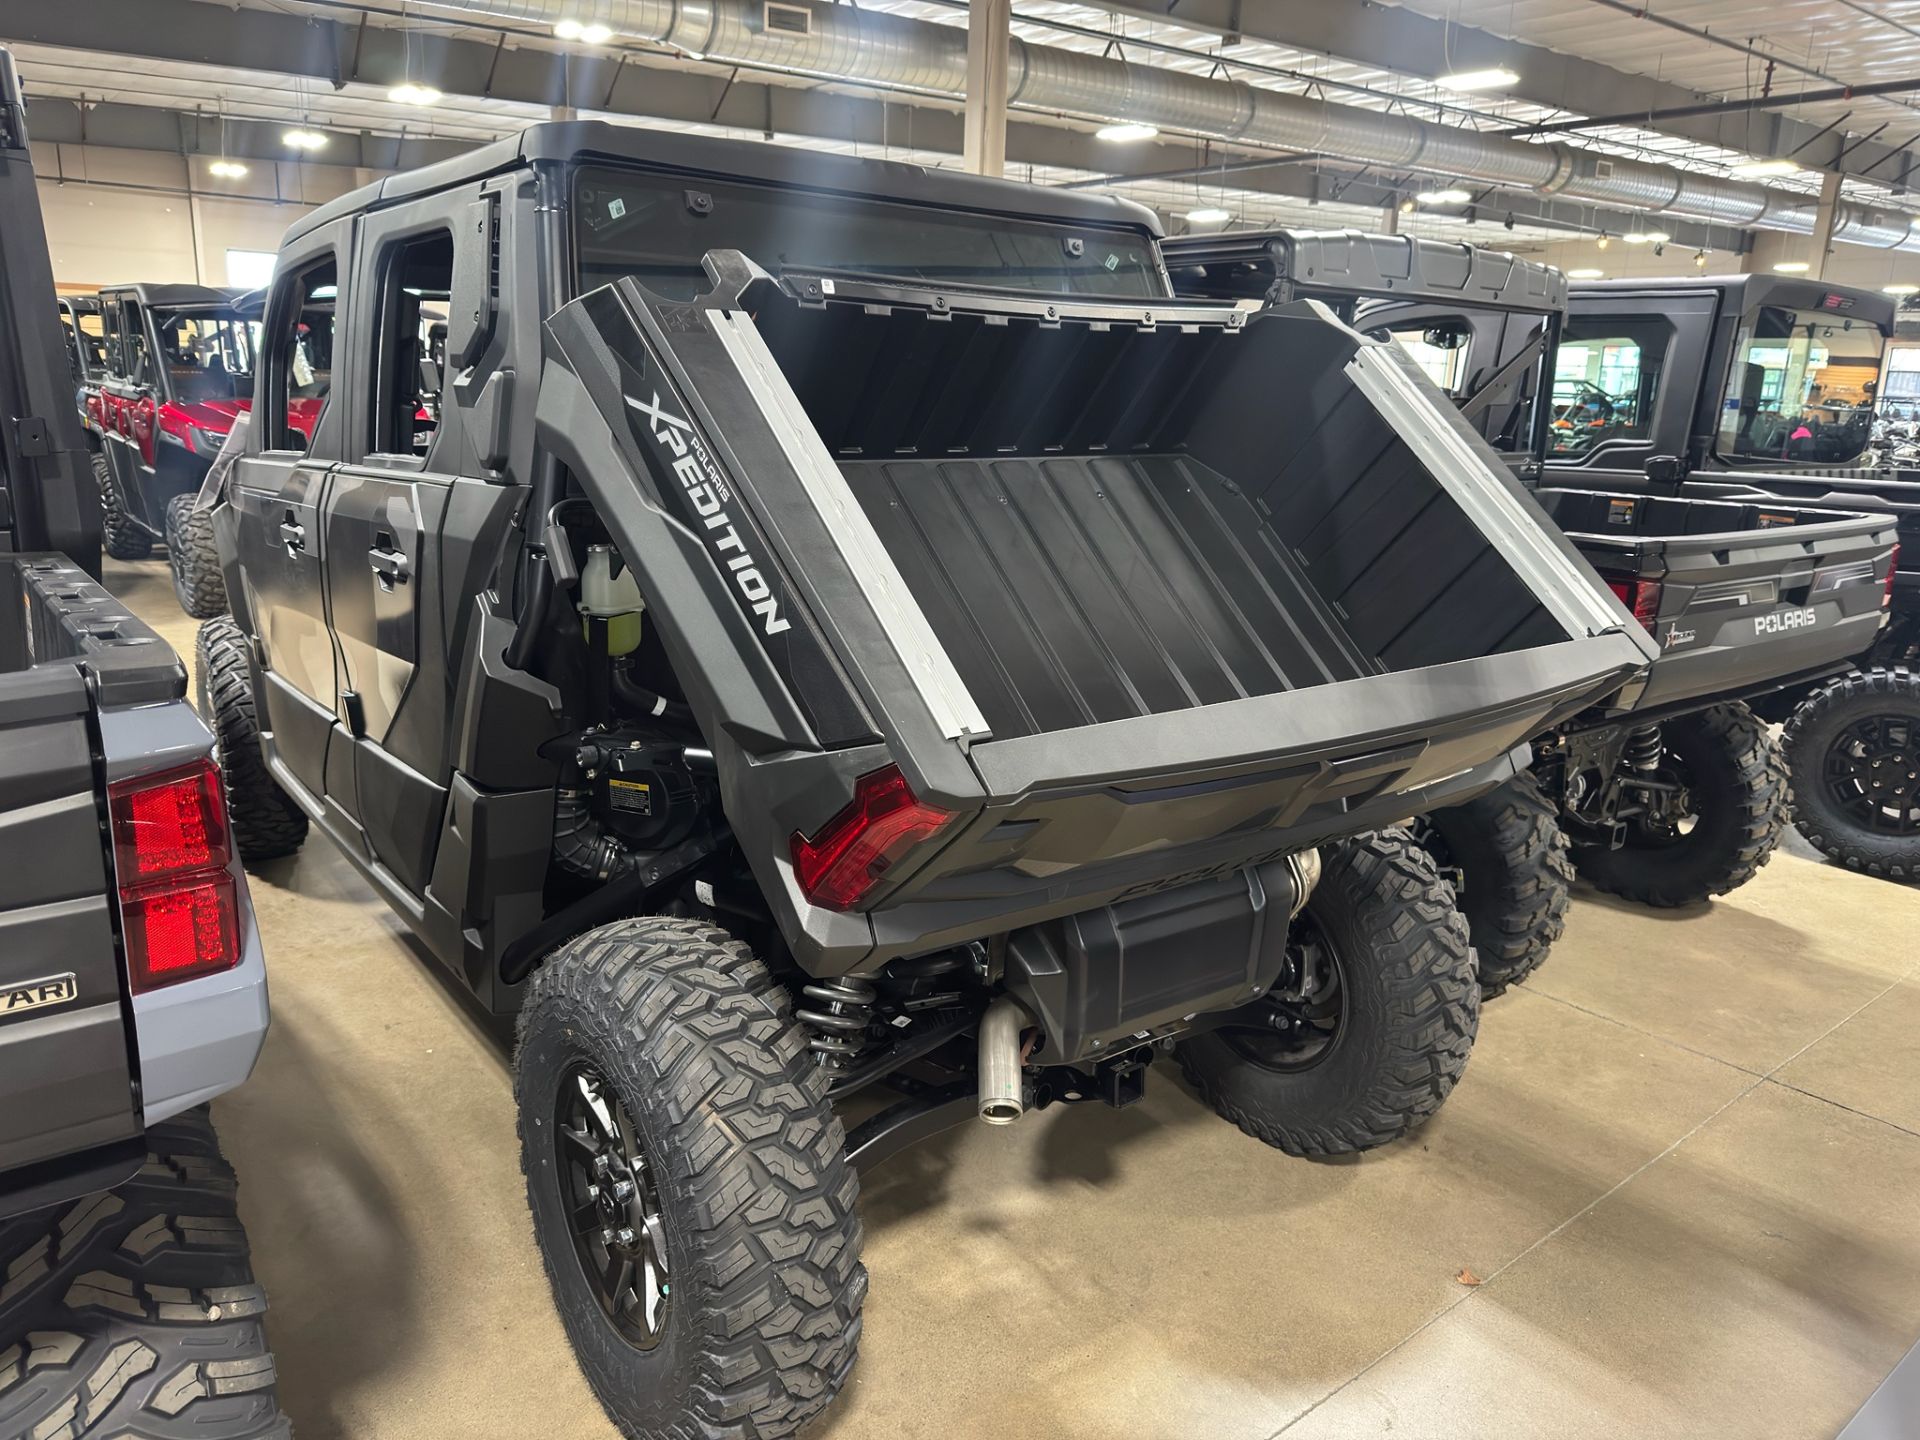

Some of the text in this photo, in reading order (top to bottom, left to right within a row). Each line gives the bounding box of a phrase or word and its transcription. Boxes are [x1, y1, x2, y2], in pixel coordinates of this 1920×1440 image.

[690, 436, 731, 503] POLARIS
[623, 389, 792, 635] XPEDITION
[1754, 607, 1816, 635] POLARIS
